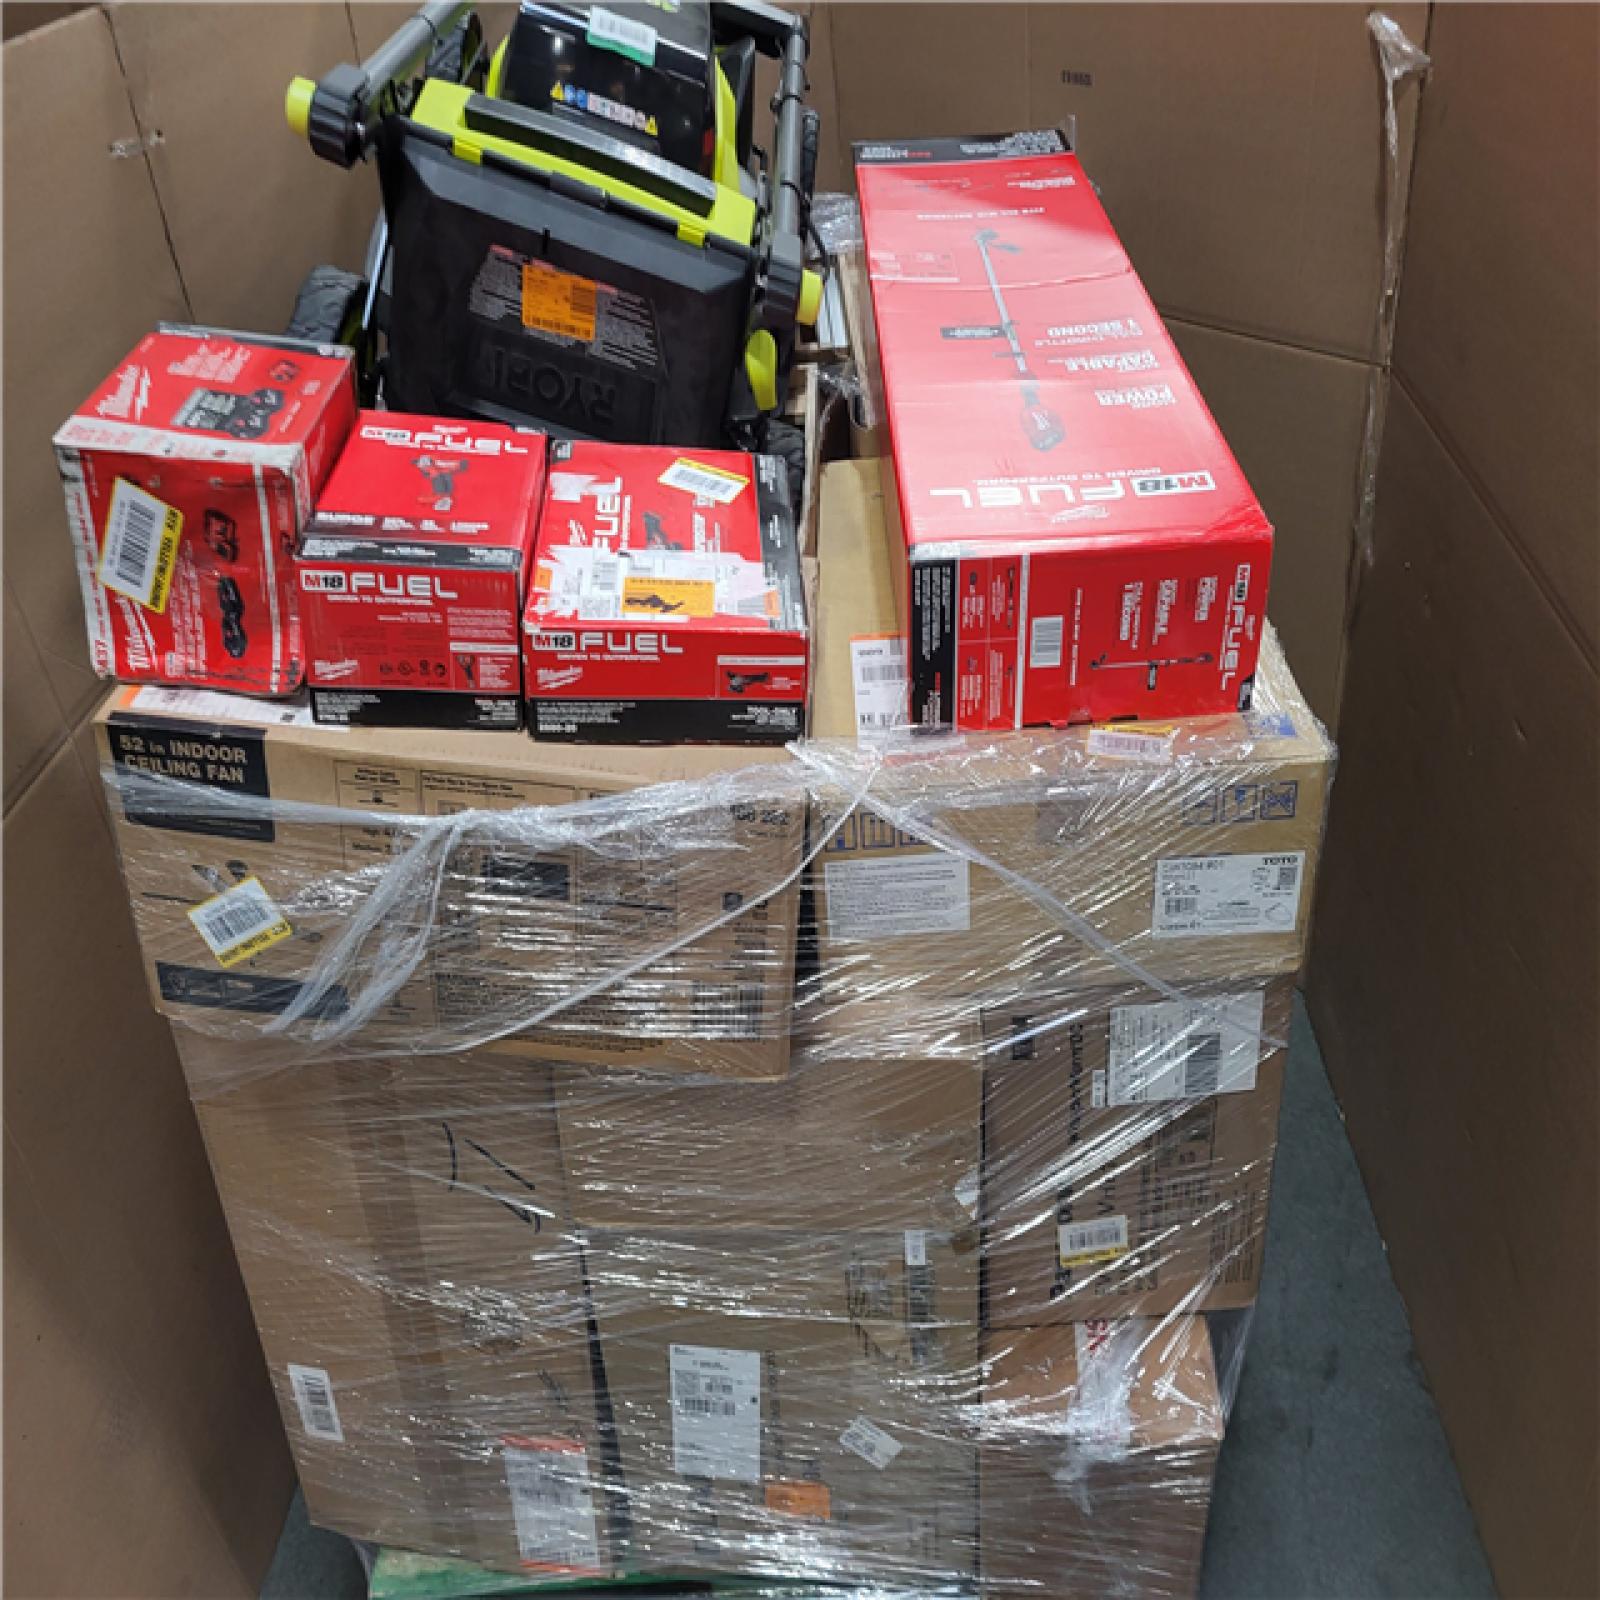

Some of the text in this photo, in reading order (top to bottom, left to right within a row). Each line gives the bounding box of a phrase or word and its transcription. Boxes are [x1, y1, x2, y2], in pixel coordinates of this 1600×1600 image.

[929, 479, 1126, 509] FUEL
[303, 571, 459, 599] M18 FUEL
[533, 631, 684, 654] M18 FUEL
[119, 735, 145, 750] 52
[169, 739, 248, 763] INDOOR
[125, 754, 245, 784] CEILING FAN
